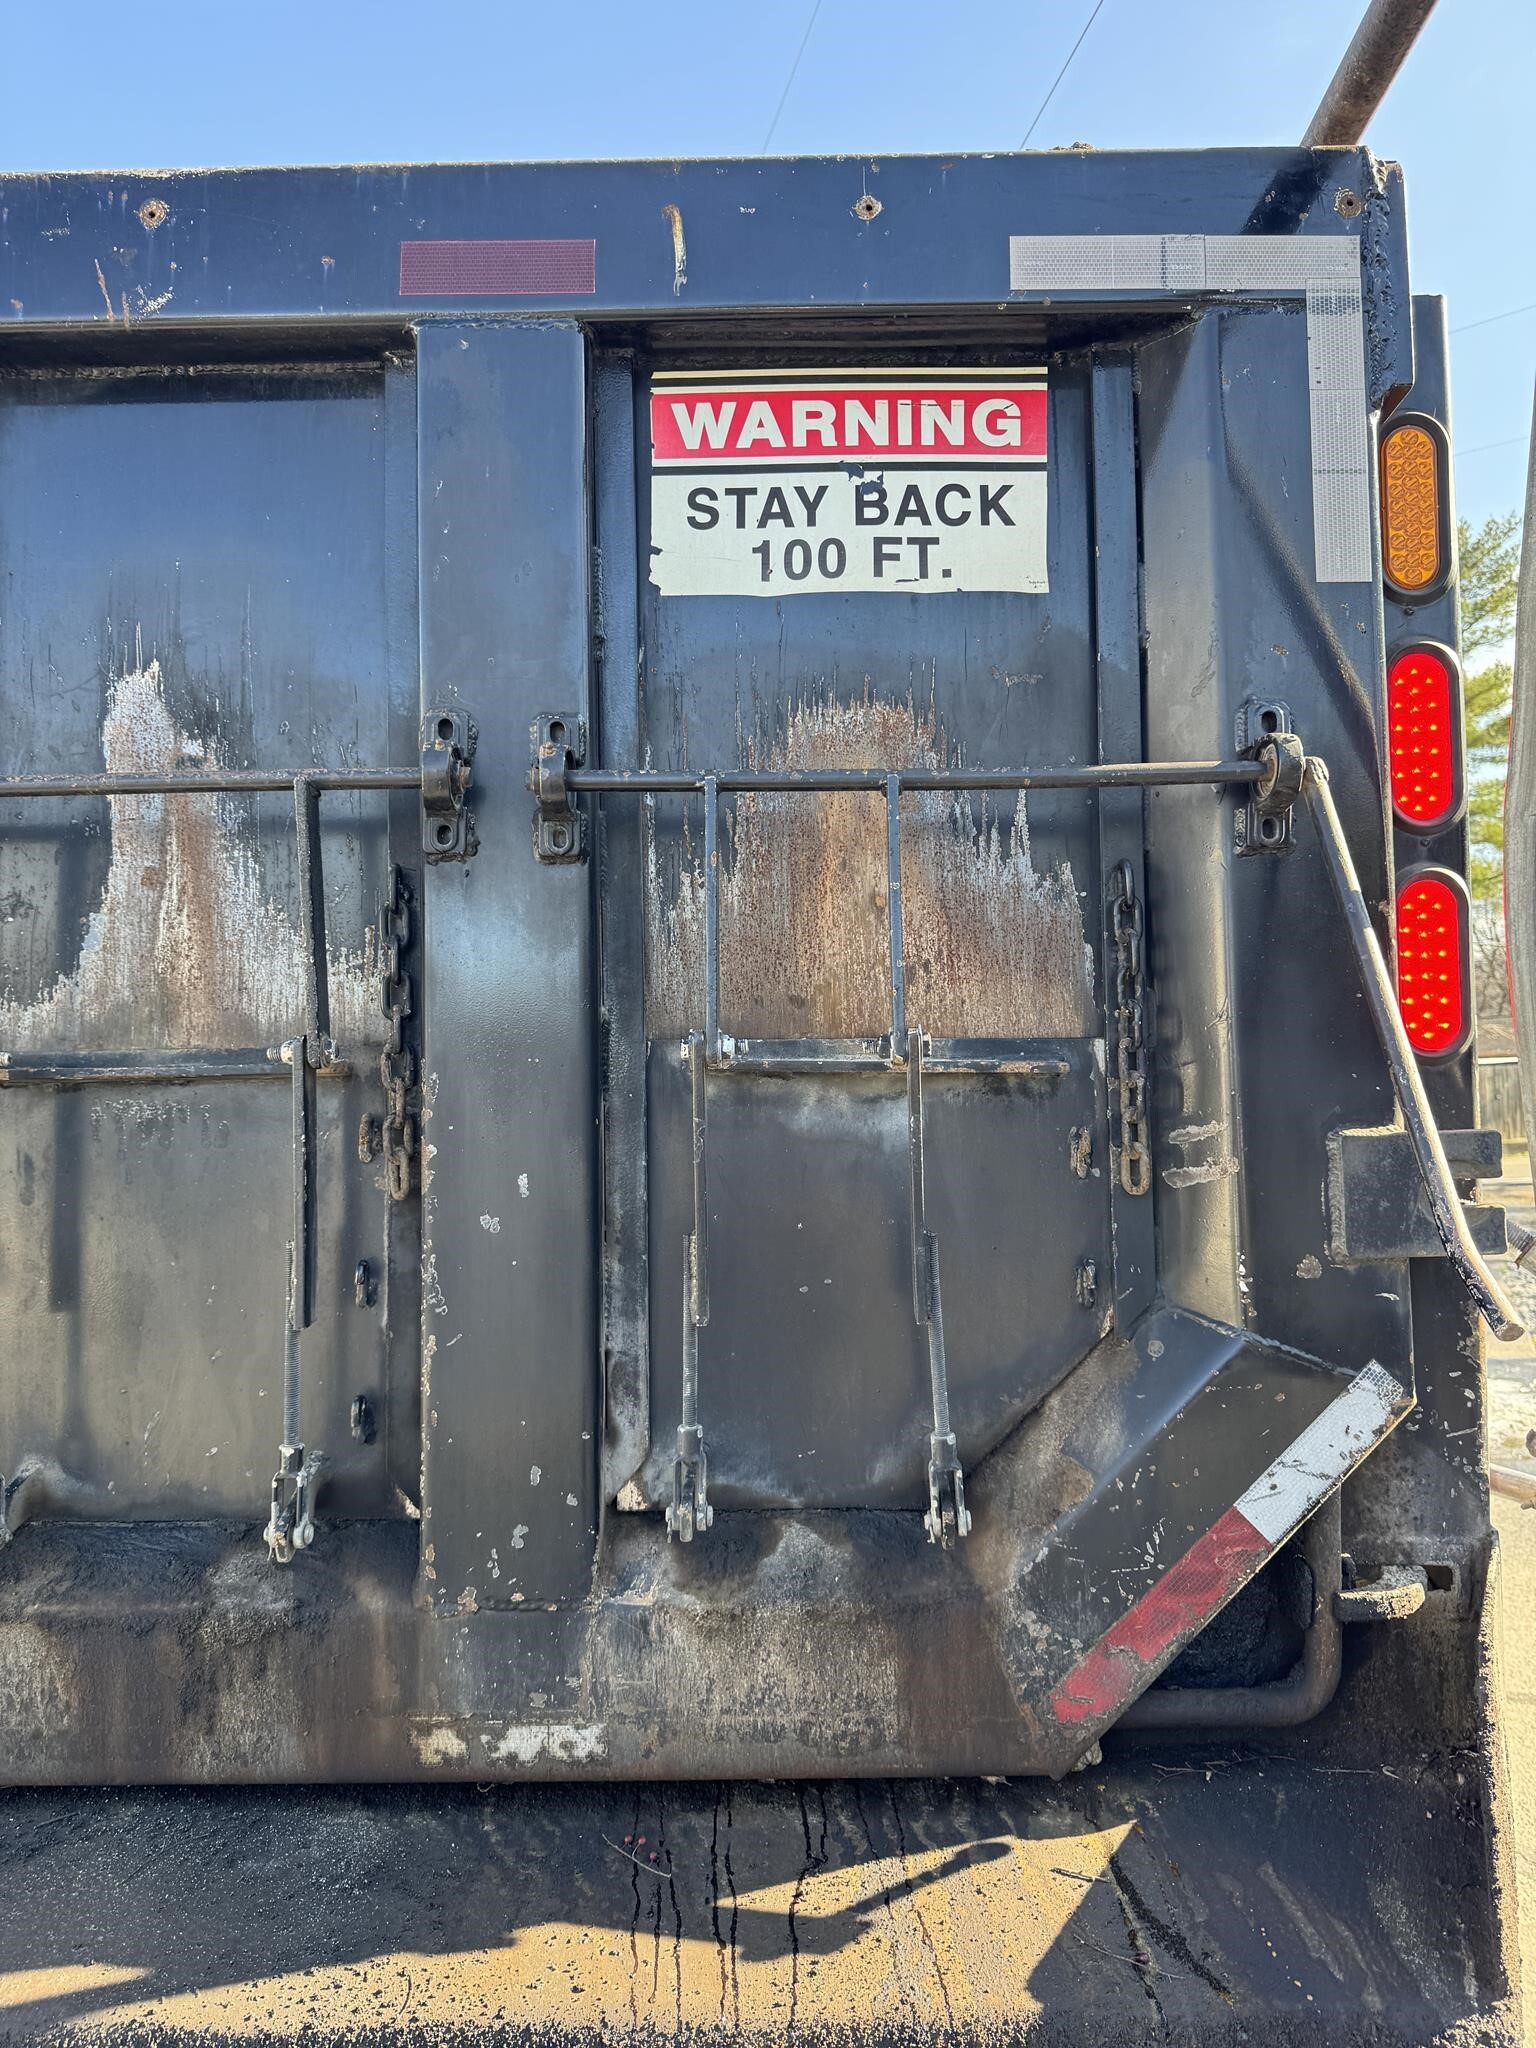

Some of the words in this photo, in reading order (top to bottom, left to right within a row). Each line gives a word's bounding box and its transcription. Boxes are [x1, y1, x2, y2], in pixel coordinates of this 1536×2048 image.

[670, 398, 1023, 450] WARNING
[686, 485, 829, 530] STAY
[854, 483, 1017, 527] BACK
[751, 537, 847, 582] 100
[873, 536, 952, 579] FT.
